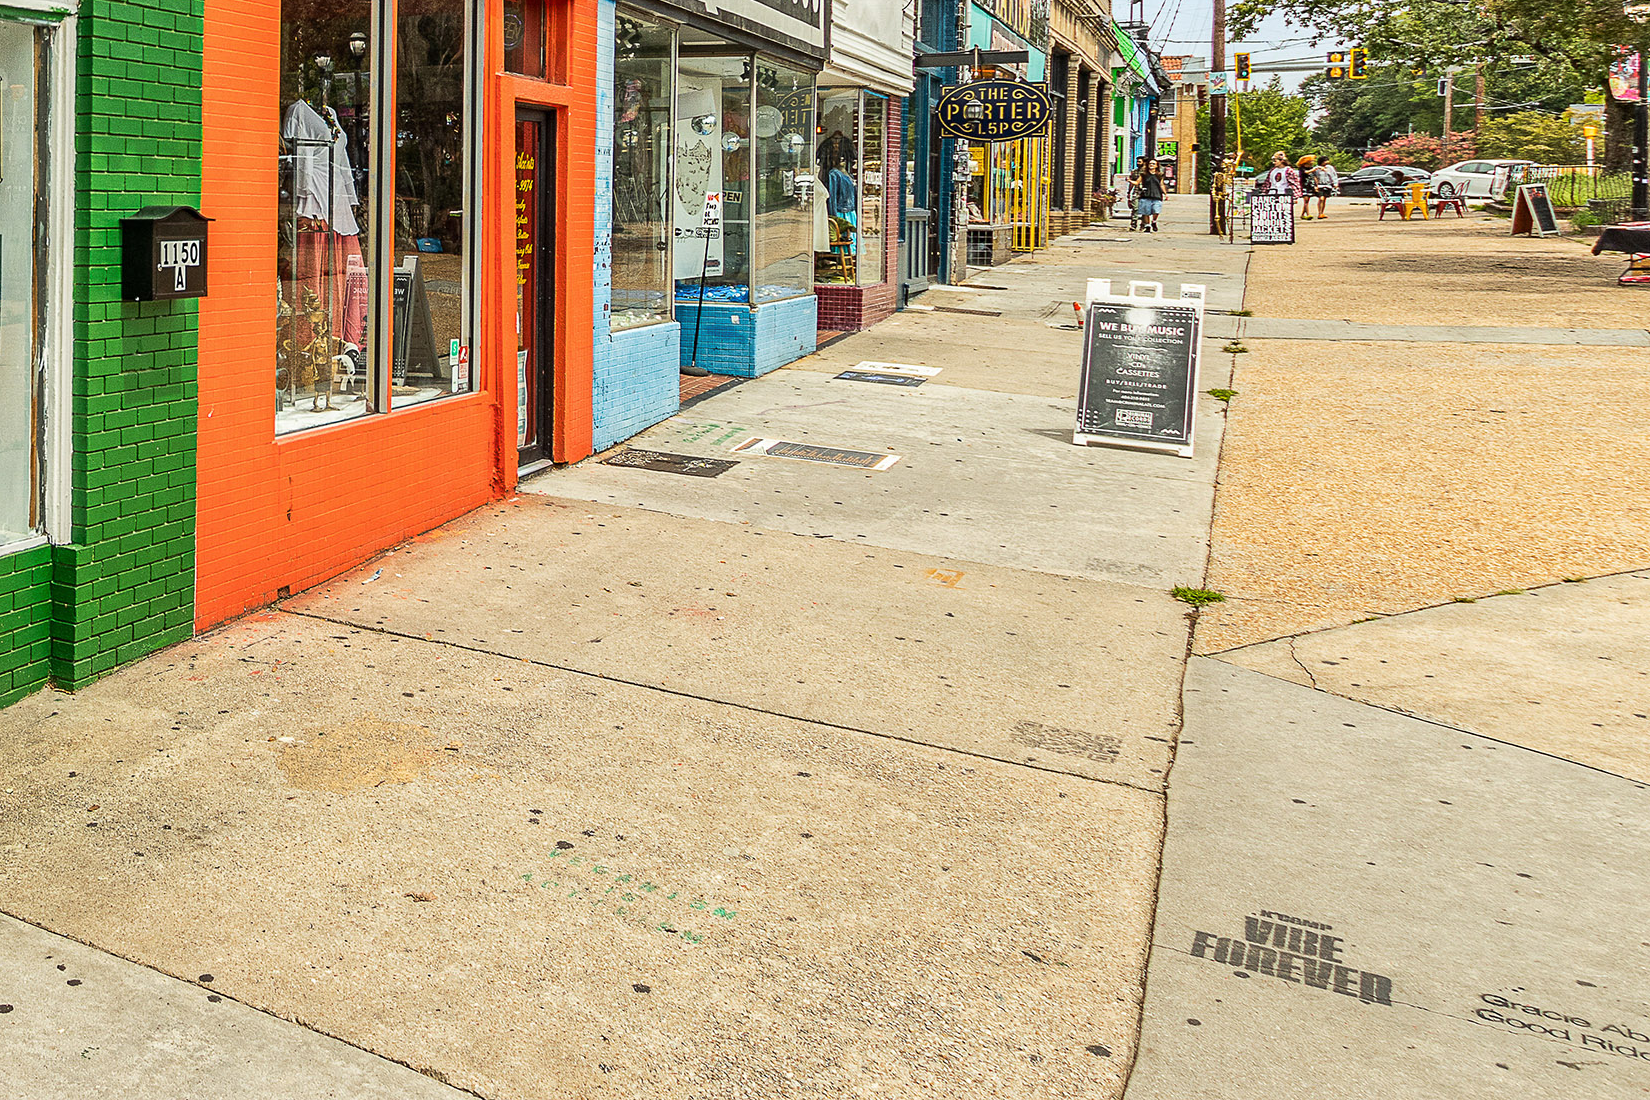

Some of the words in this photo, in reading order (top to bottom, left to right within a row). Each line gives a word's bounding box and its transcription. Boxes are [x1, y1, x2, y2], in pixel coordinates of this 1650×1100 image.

[978, 87, 1009, 100] THE
[978, 122, 1009, 135] L5P
[722, 191, 741, 202] PEN
[1251, 195, 1292, 204] BANG-ON
[1251, 203, 1292, 211] CUSTOM
[1251, 210, 1292, 220] SHIRTS
[1251, 219, 1292, 227] HOODIES
[163, 242, 199, 265] 1150
[176, 266, 185, 289] A
[1099, 321, 1119, 331] WE
[1147, 325, 1185, 336] MUSIC
[1144, 336, 1184, 344] COLLECTION
[1115, 367, 1160, 378] CASSETTES
[1244, 915, 1344, 964] VIBE
[1189, 930, 1392, 1006] FOREVER
[1480, 993, 1593, 1028] Gracie
[1475, 1008, 1572, 1041] Good
